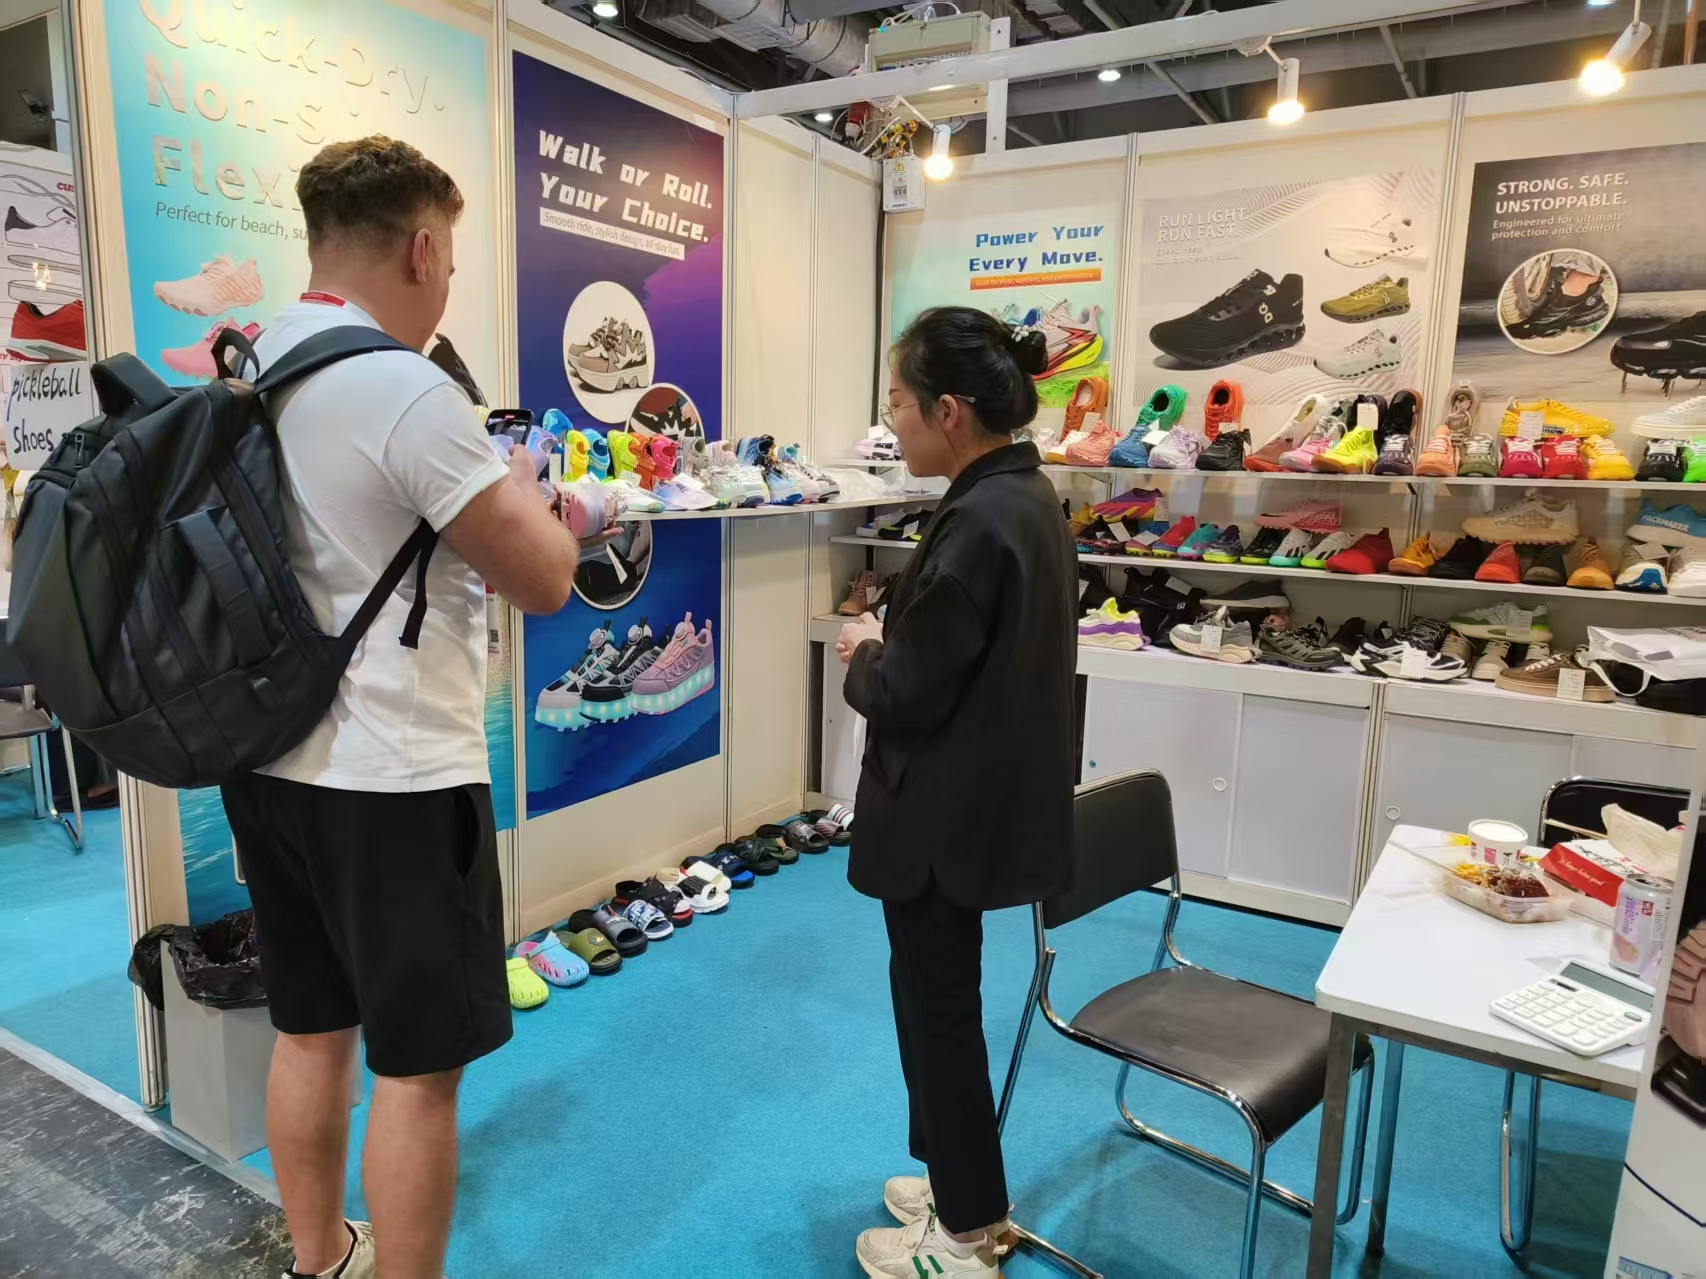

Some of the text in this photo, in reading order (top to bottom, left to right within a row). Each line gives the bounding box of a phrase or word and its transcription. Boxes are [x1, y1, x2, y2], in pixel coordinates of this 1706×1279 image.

[539, 129, 713, 209] Walk or Roll.
[1496, 172, 1630, 196] STRONG. SAFE.
[540, 171, 709, 243] Your Choice.
[1495, 192, 1628, 214] UNSTOPPABLE.
[155, 201, 309, 240] Perfect for beach, su
[544, 212, 576, 229] Smooth
[576, 219, 595, 235] ride,
[1159, 207, 1249, 229] RUN LIGHT.
[1492, 216, 1555, 230] Engineered
[1557, 215, 1573, 225] for
[976, 224, 1105, 248] Power Your
[1158, 226, 1193, 243] RUN
[1491, 223, 1625, 241] protection and comfort.
[969, 250, 1104, 272] Every Move.
[6, 367, 82, 421] pickleball
